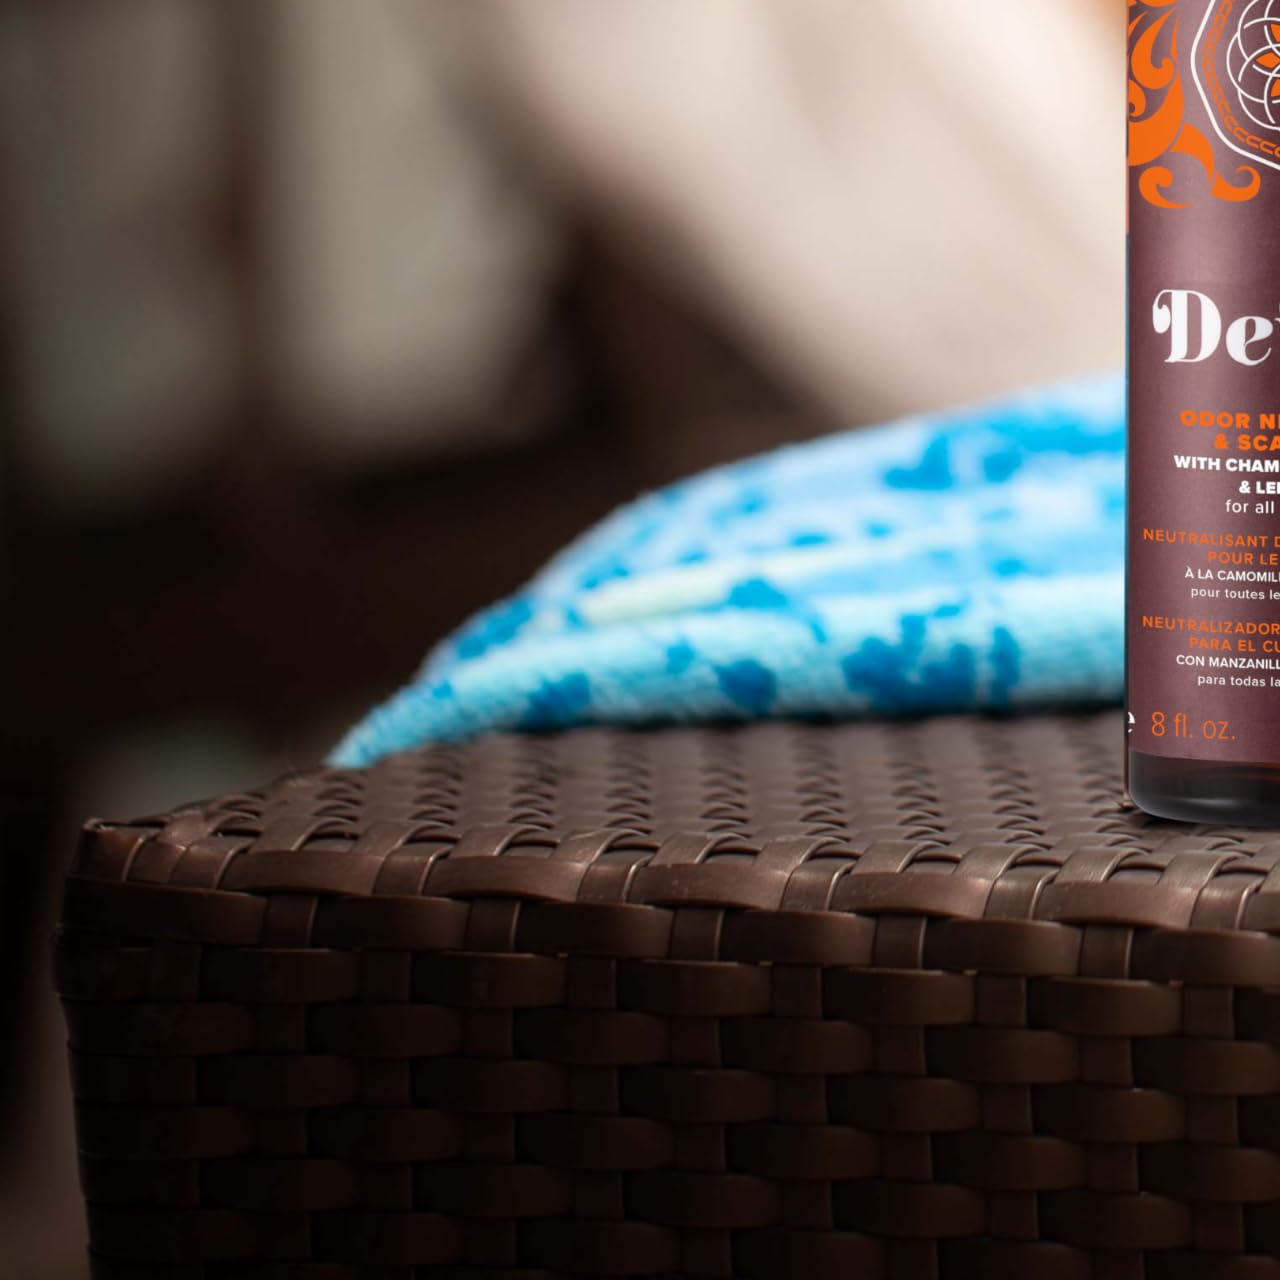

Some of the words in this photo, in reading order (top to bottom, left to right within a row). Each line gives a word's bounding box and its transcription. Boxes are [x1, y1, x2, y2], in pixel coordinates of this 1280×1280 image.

[1180, 410, 1251, 429] ODOR
[1213, 433, 1229, 450] &
[1174, 455, 1221, 471] WITH
[1239, 481, 1251, 494] &
[1225, 499, 1249, 514] for
[1256, 501, 1275, 514] all
[1143, 528, 1267, 548] NEUTRALISANT
[1208, 552, 1254, 564] POUR
[1259, 553, 1279, 566] LE
[1184, 566, 1194, 579] À
[1198, 569, 1214, 580] LA
[1190, 588, 1221, 599] pour
[1225, 589, 1265, 600] toutes
[1142, 615, 1280, 636] NEUTRALIZADOR
[1189, 636, 1233, 651] PARA
[1237, 640, 1256, 652] EL
[1177, 655, 1205, 667] CON
[1197, 675, 1226, 687] para
[1230, 676, 1266, 687] todas
[1152, 711, 1166, 737] 8
[1174, 711, 1193, 738] fl.
[1202, 720, 1237, 741] oz.
